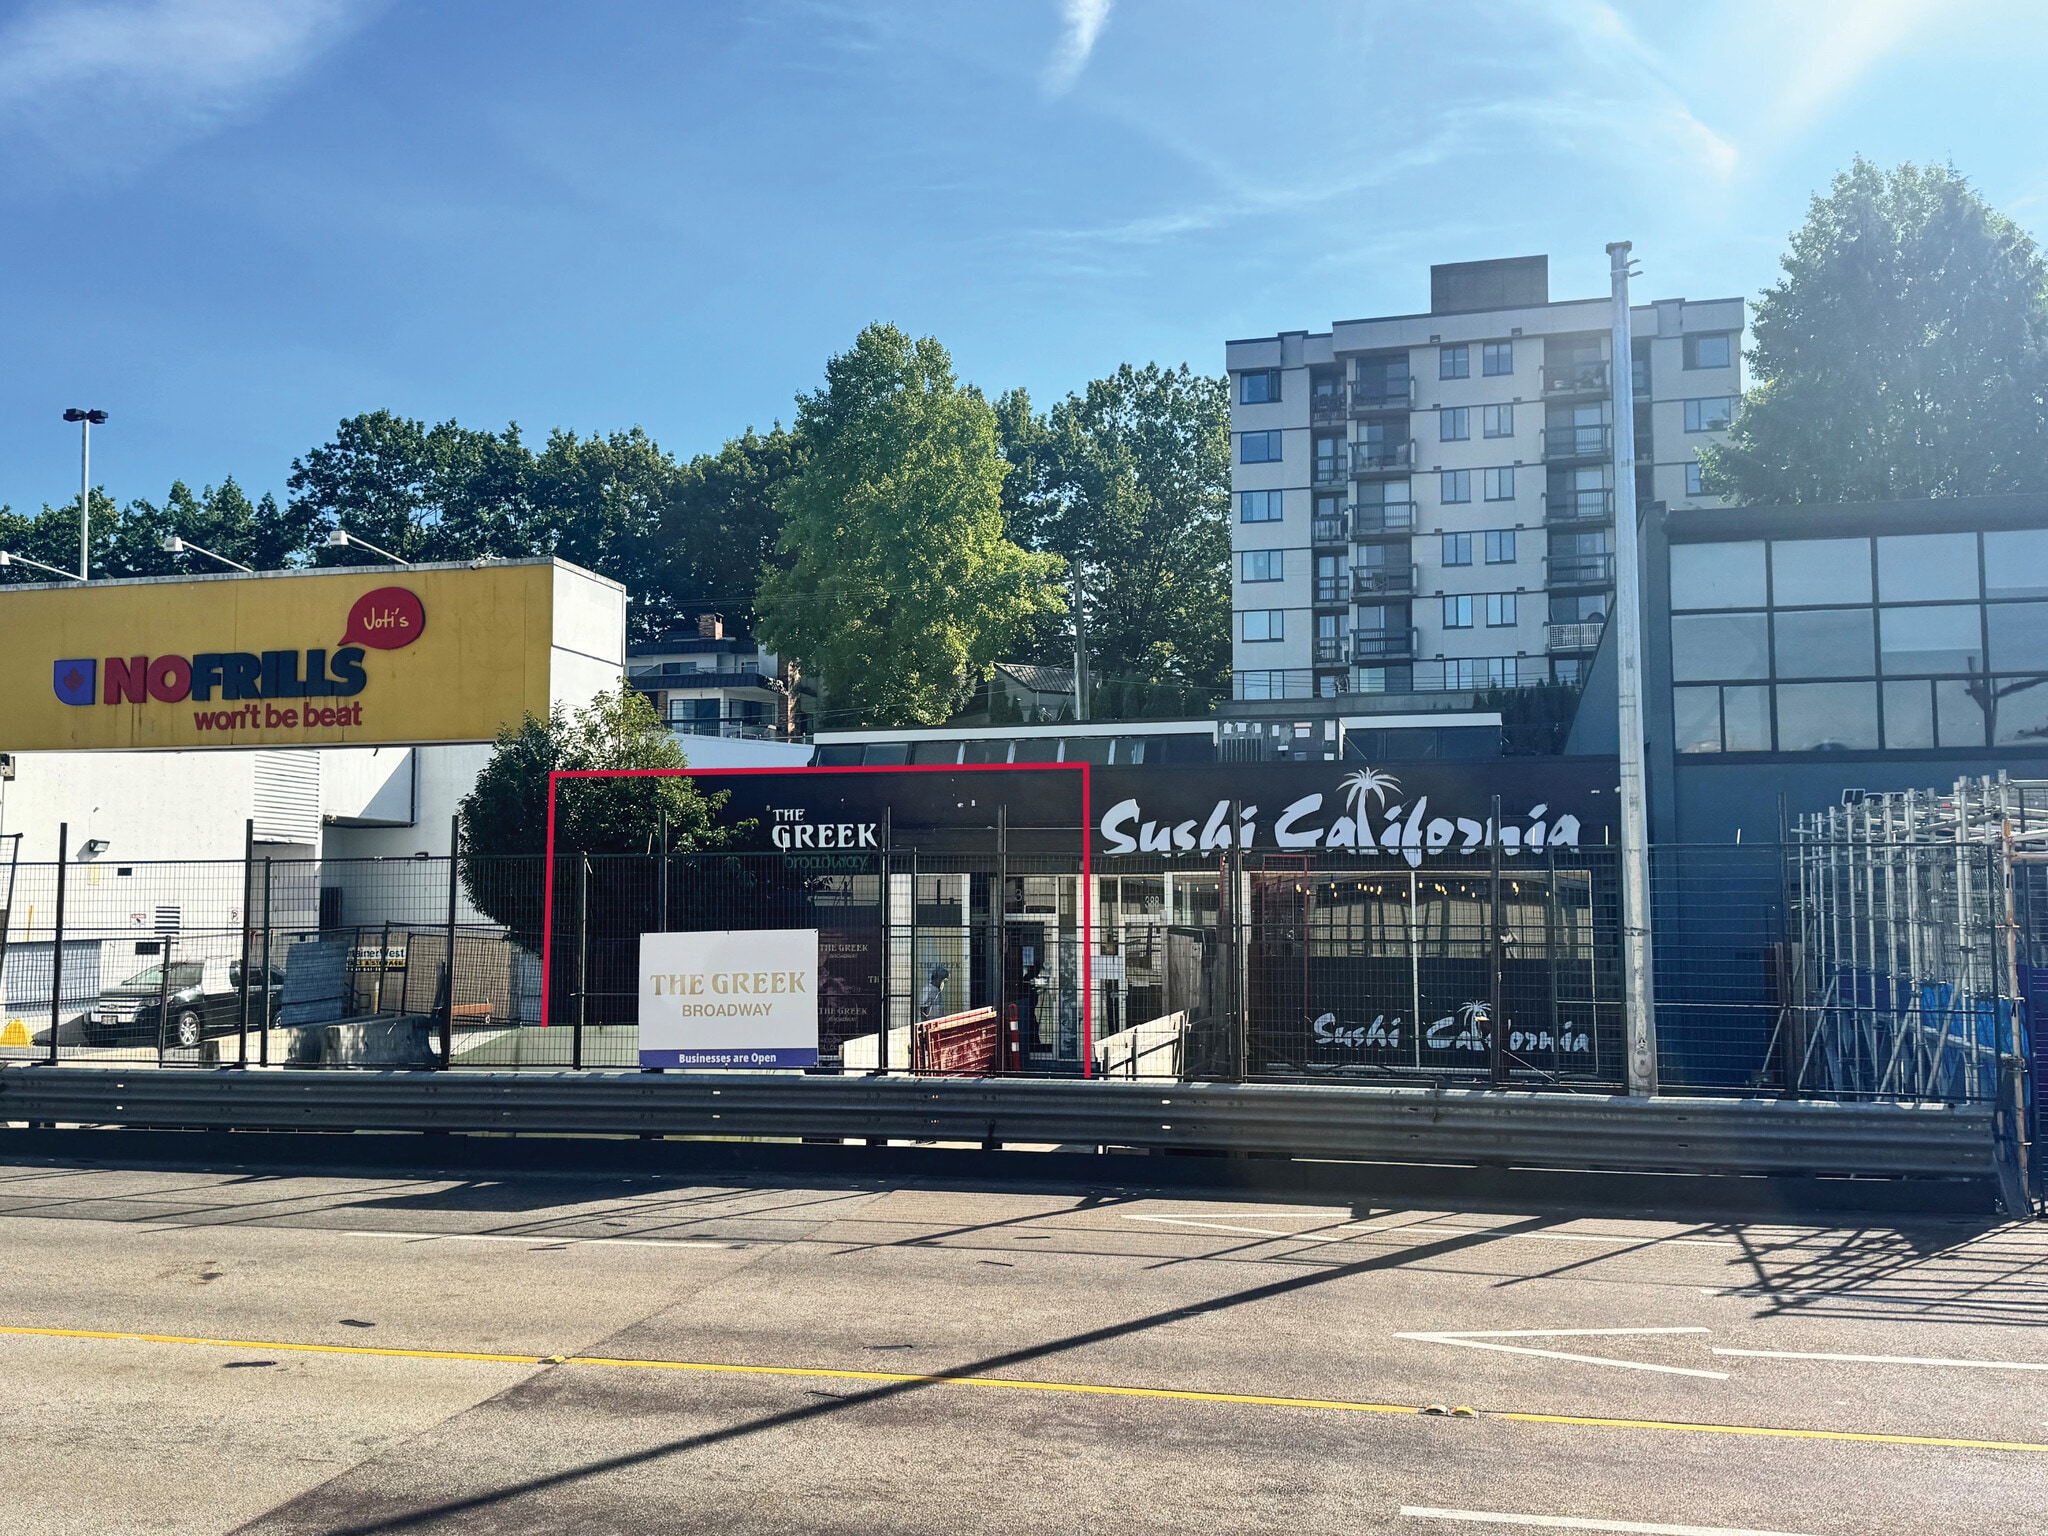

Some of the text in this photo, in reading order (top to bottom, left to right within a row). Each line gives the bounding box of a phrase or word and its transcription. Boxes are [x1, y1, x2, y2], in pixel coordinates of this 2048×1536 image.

[363, 607, 409, 630] Joti's
[194, 701, 363, 731] won't be beat
[772, 808, 805, 821] THE
[1100, 767, 1581, 868] Sushi California
[771, 823, 878, 848] GREEK
[784, 854, 868, 871] broadway
[650, 971, 806, 995] THE GREEK
[682, 1003, 773, 1017] BROADWAY
[839, 1007, 868, 1015] GREEK
[1313, 1012, 1400, 1048] Sushi
[678, 1053, 777, 1065] Businesses are Open
